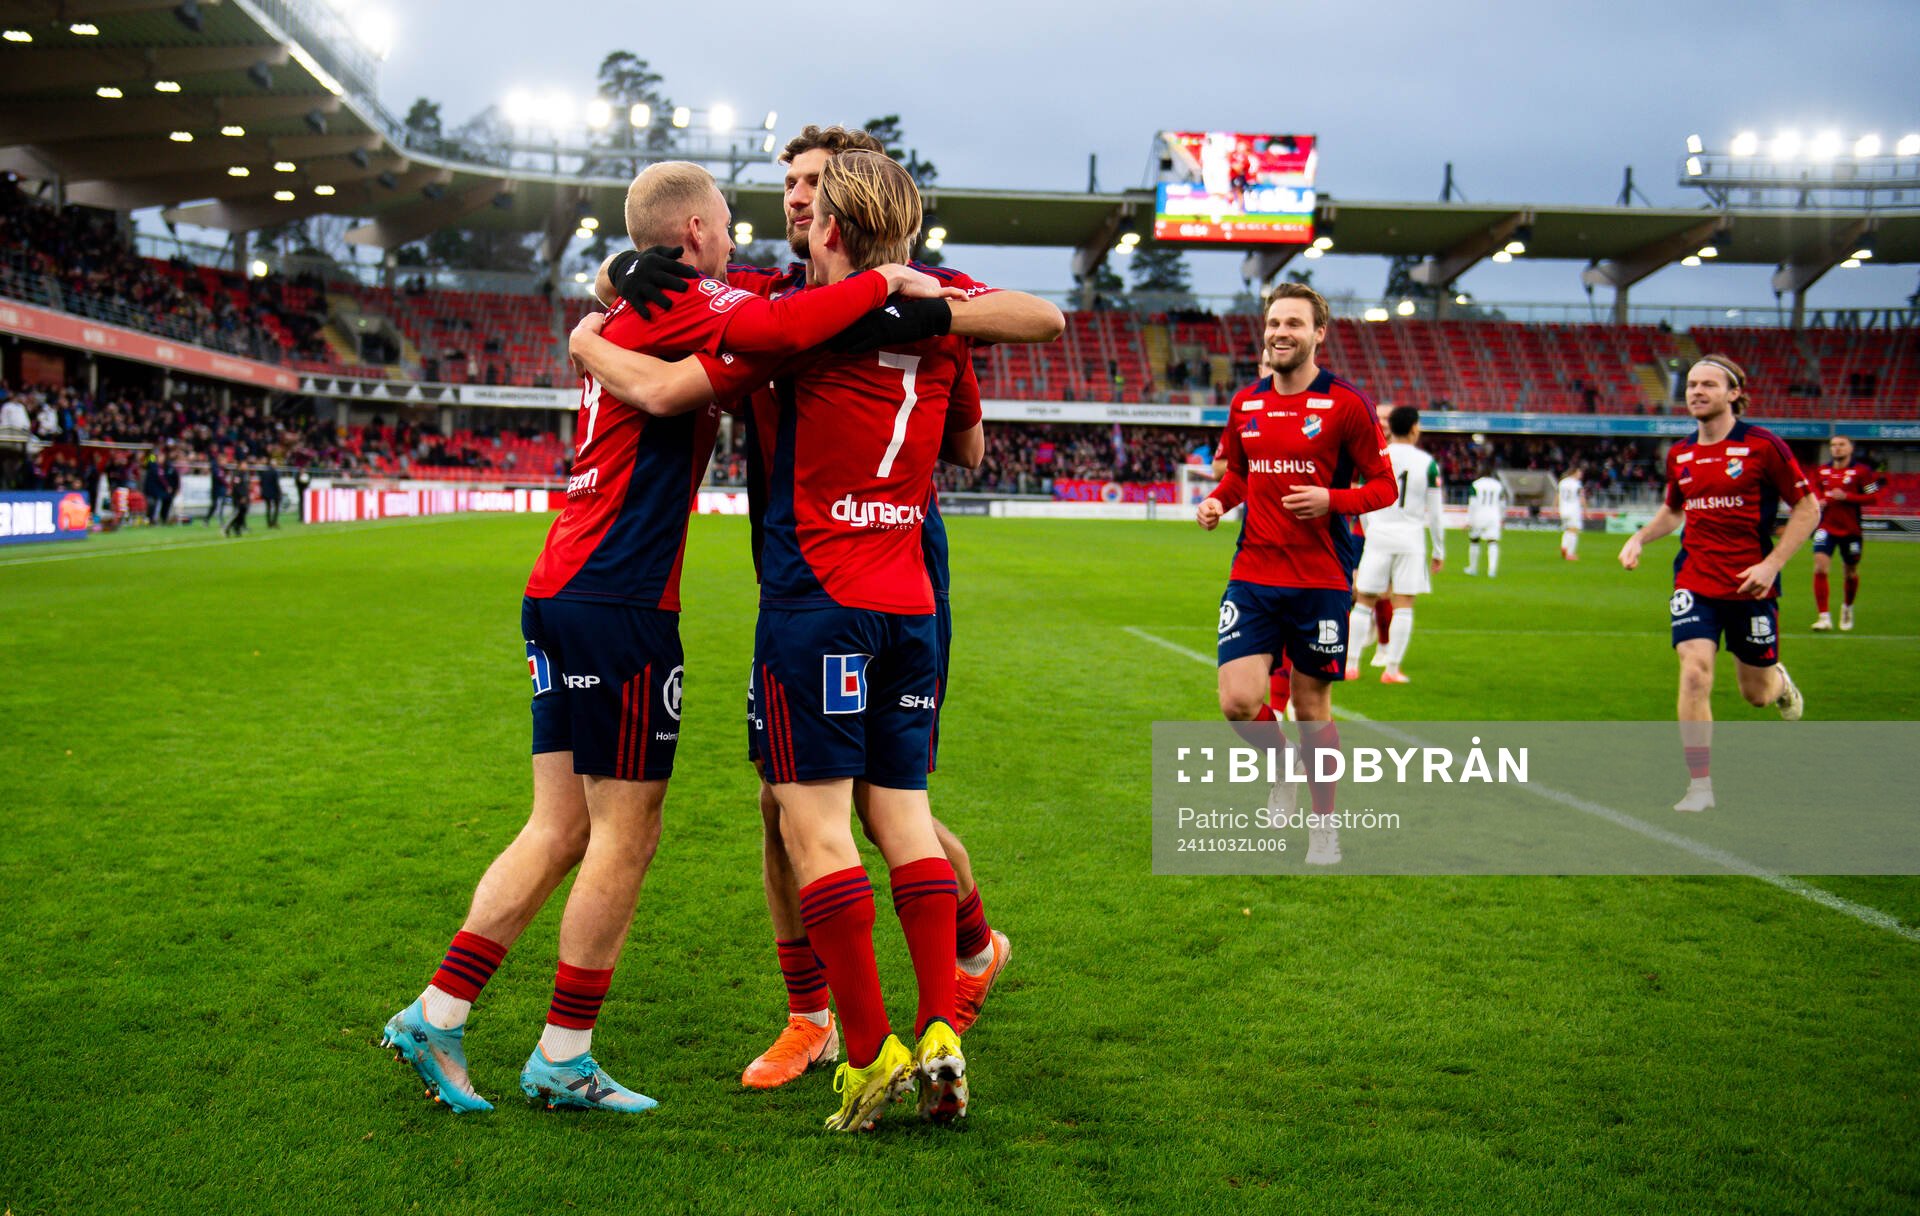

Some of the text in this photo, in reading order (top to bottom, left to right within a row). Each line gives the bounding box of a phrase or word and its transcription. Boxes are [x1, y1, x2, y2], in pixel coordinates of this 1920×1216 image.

[878, 350, 922, 477] 7
[1249, 459, 1316, 474] MILSHUS
[1685, 495, 1744, 511] MILSHUS
